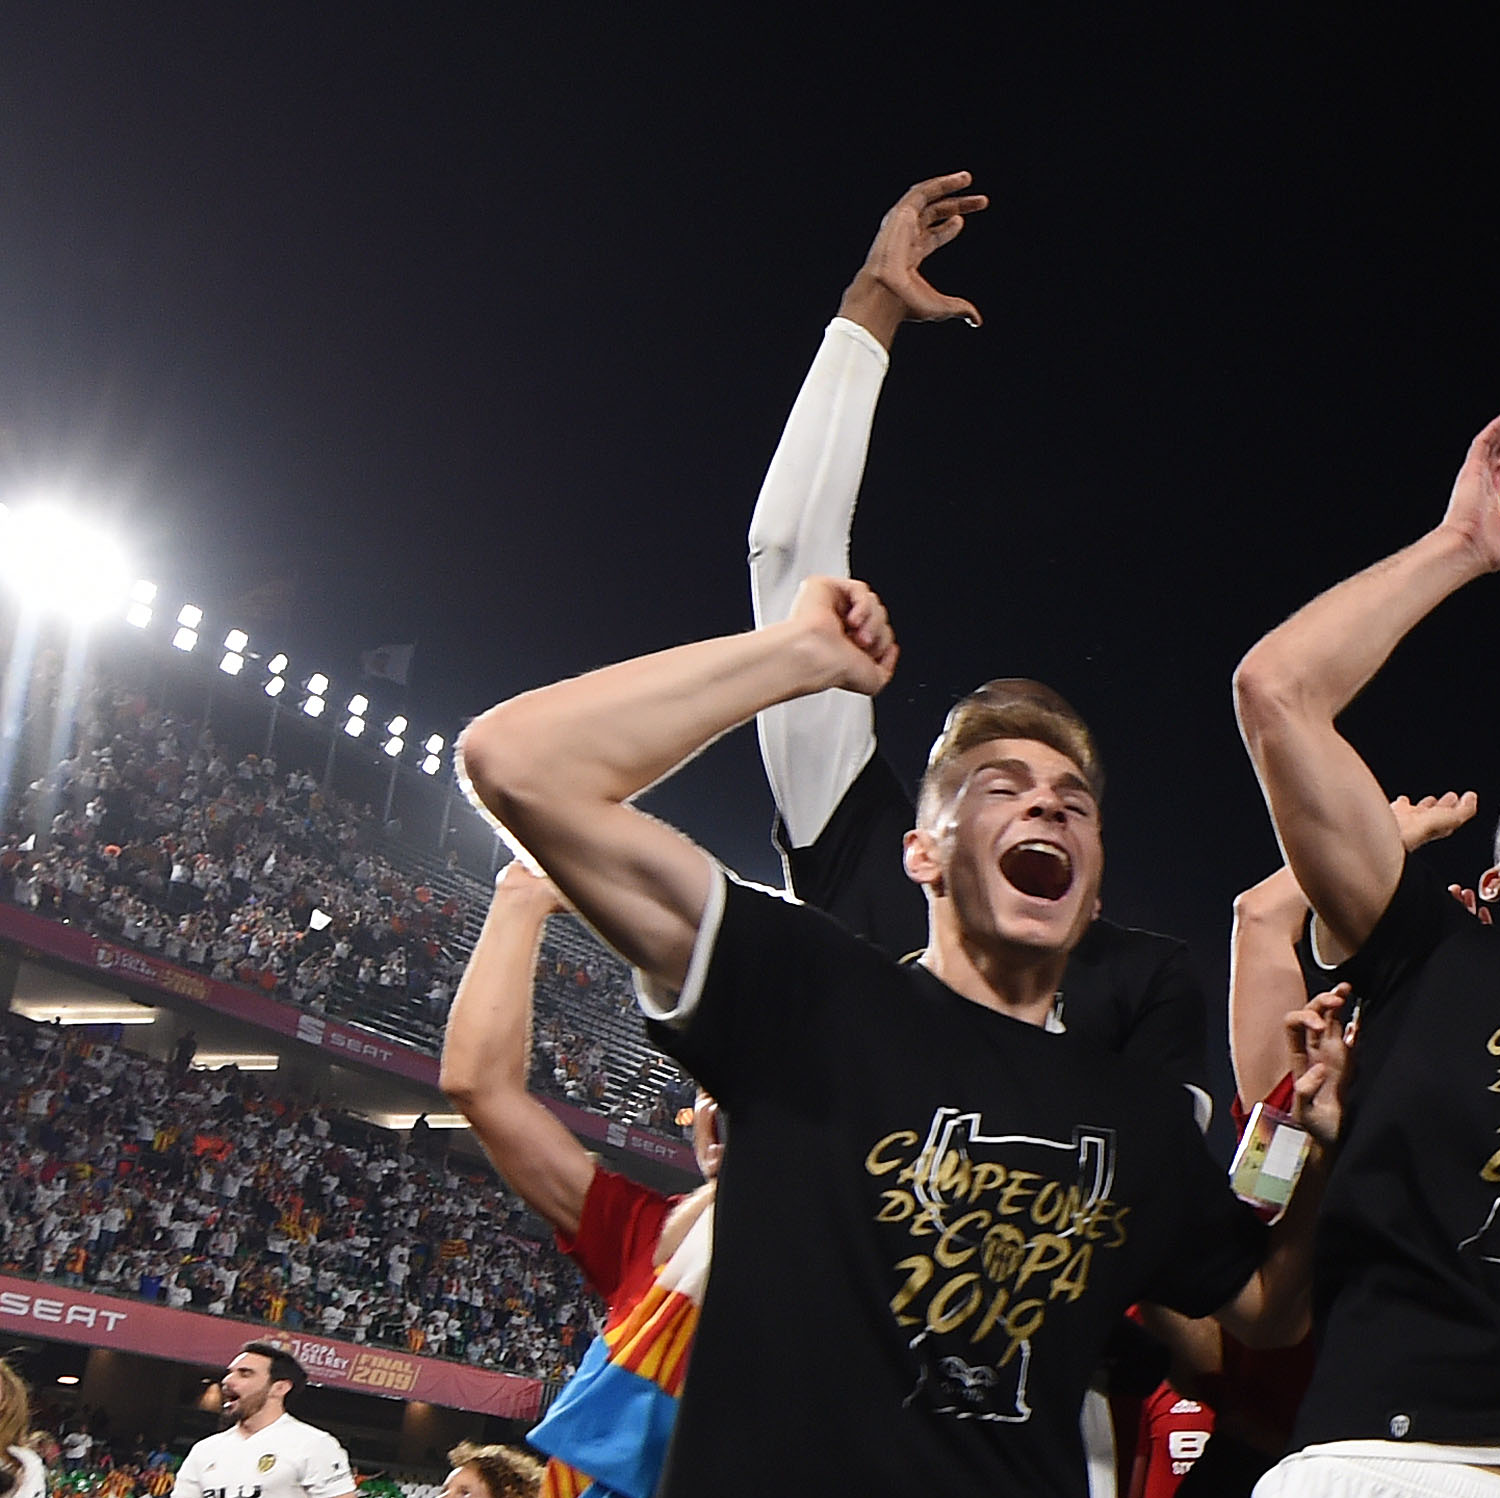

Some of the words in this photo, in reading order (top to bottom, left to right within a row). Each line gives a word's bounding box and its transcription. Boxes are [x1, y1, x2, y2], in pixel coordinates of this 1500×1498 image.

[329, 1031, 393, 1063] SEAT
[631, 1132, 679, 1159] SEAT
[864, 1130, 1133, 1248] CAMPEONES
[874, 1189, 951, 1236] DE
[0, 1292, 127, 1333] SEAT
[888, 1253, 1046, 1368] 2019
[352, 1365, 414, 1391] 2019
[357, 1353, 413, 1371] FINAL
